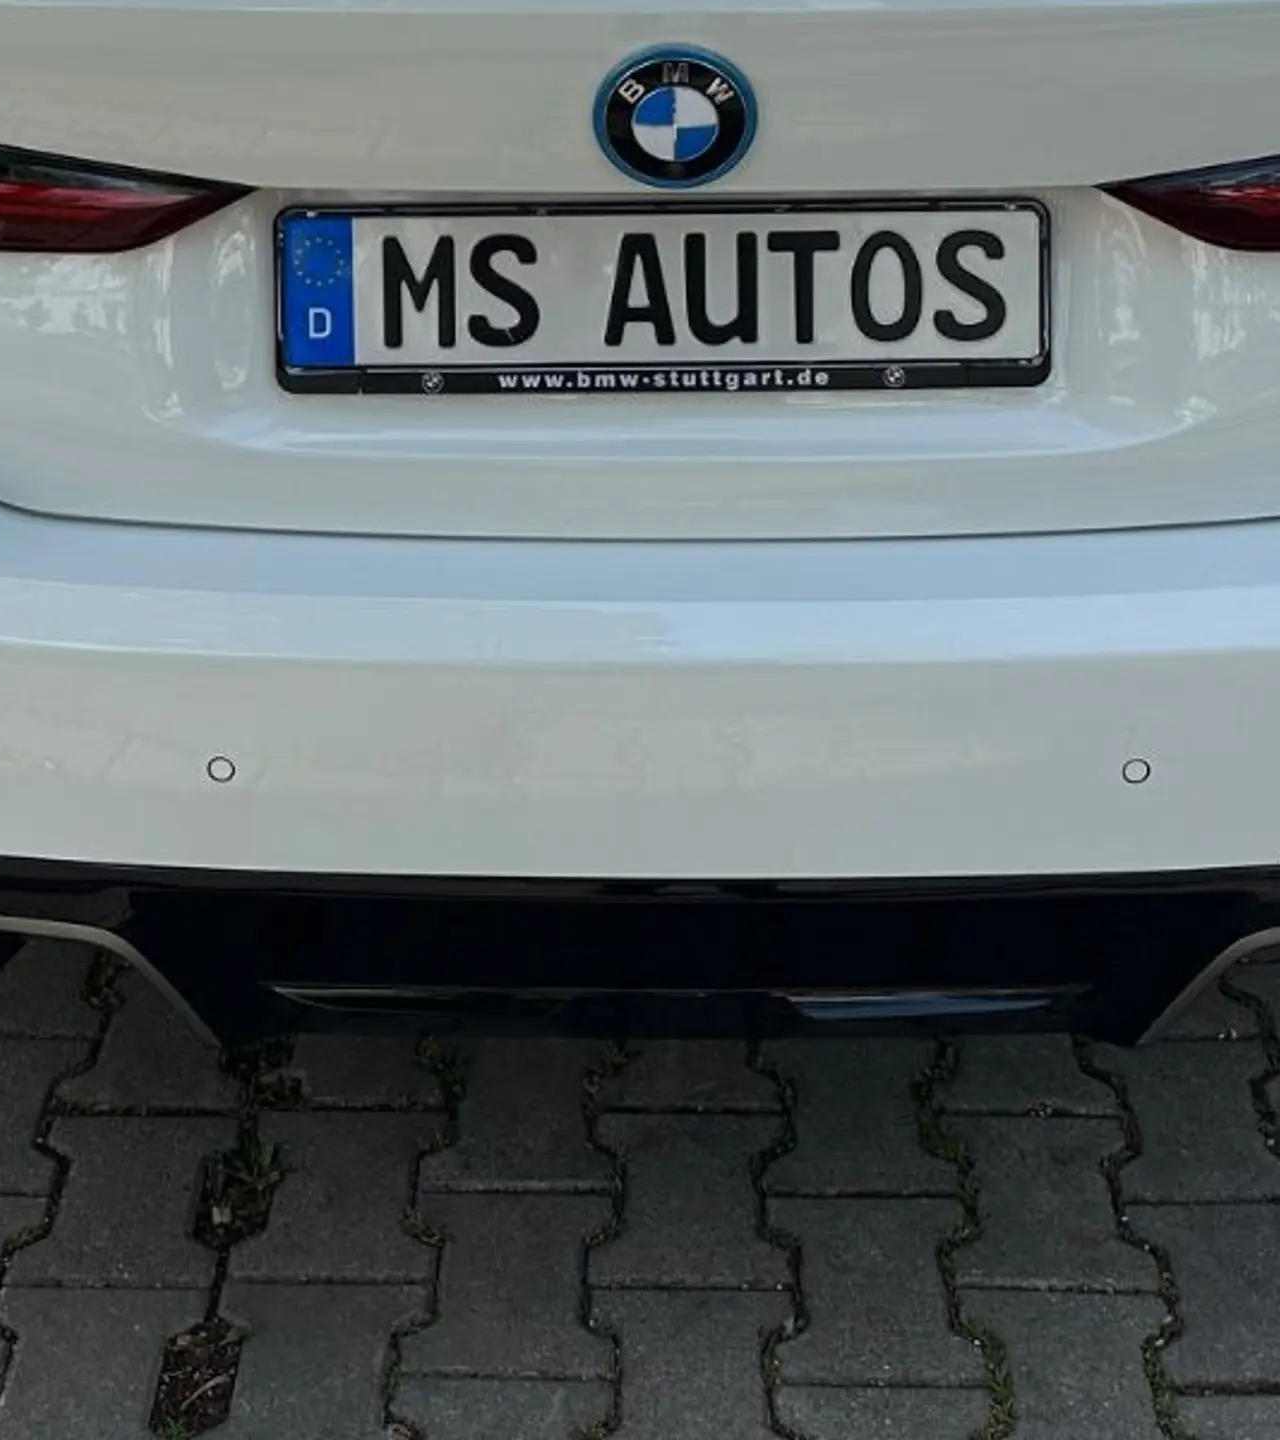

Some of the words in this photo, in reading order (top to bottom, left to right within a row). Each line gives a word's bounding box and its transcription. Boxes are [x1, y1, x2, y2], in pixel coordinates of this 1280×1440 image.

[617, 62, 736, 106] BMW
[382, 234, 541, 349] MS
[604, 229, 1008, 346] AUTOS
[307, 306, 333, 340] D
[498, 369, 830, 390] www.bmw-stuttgart.de
